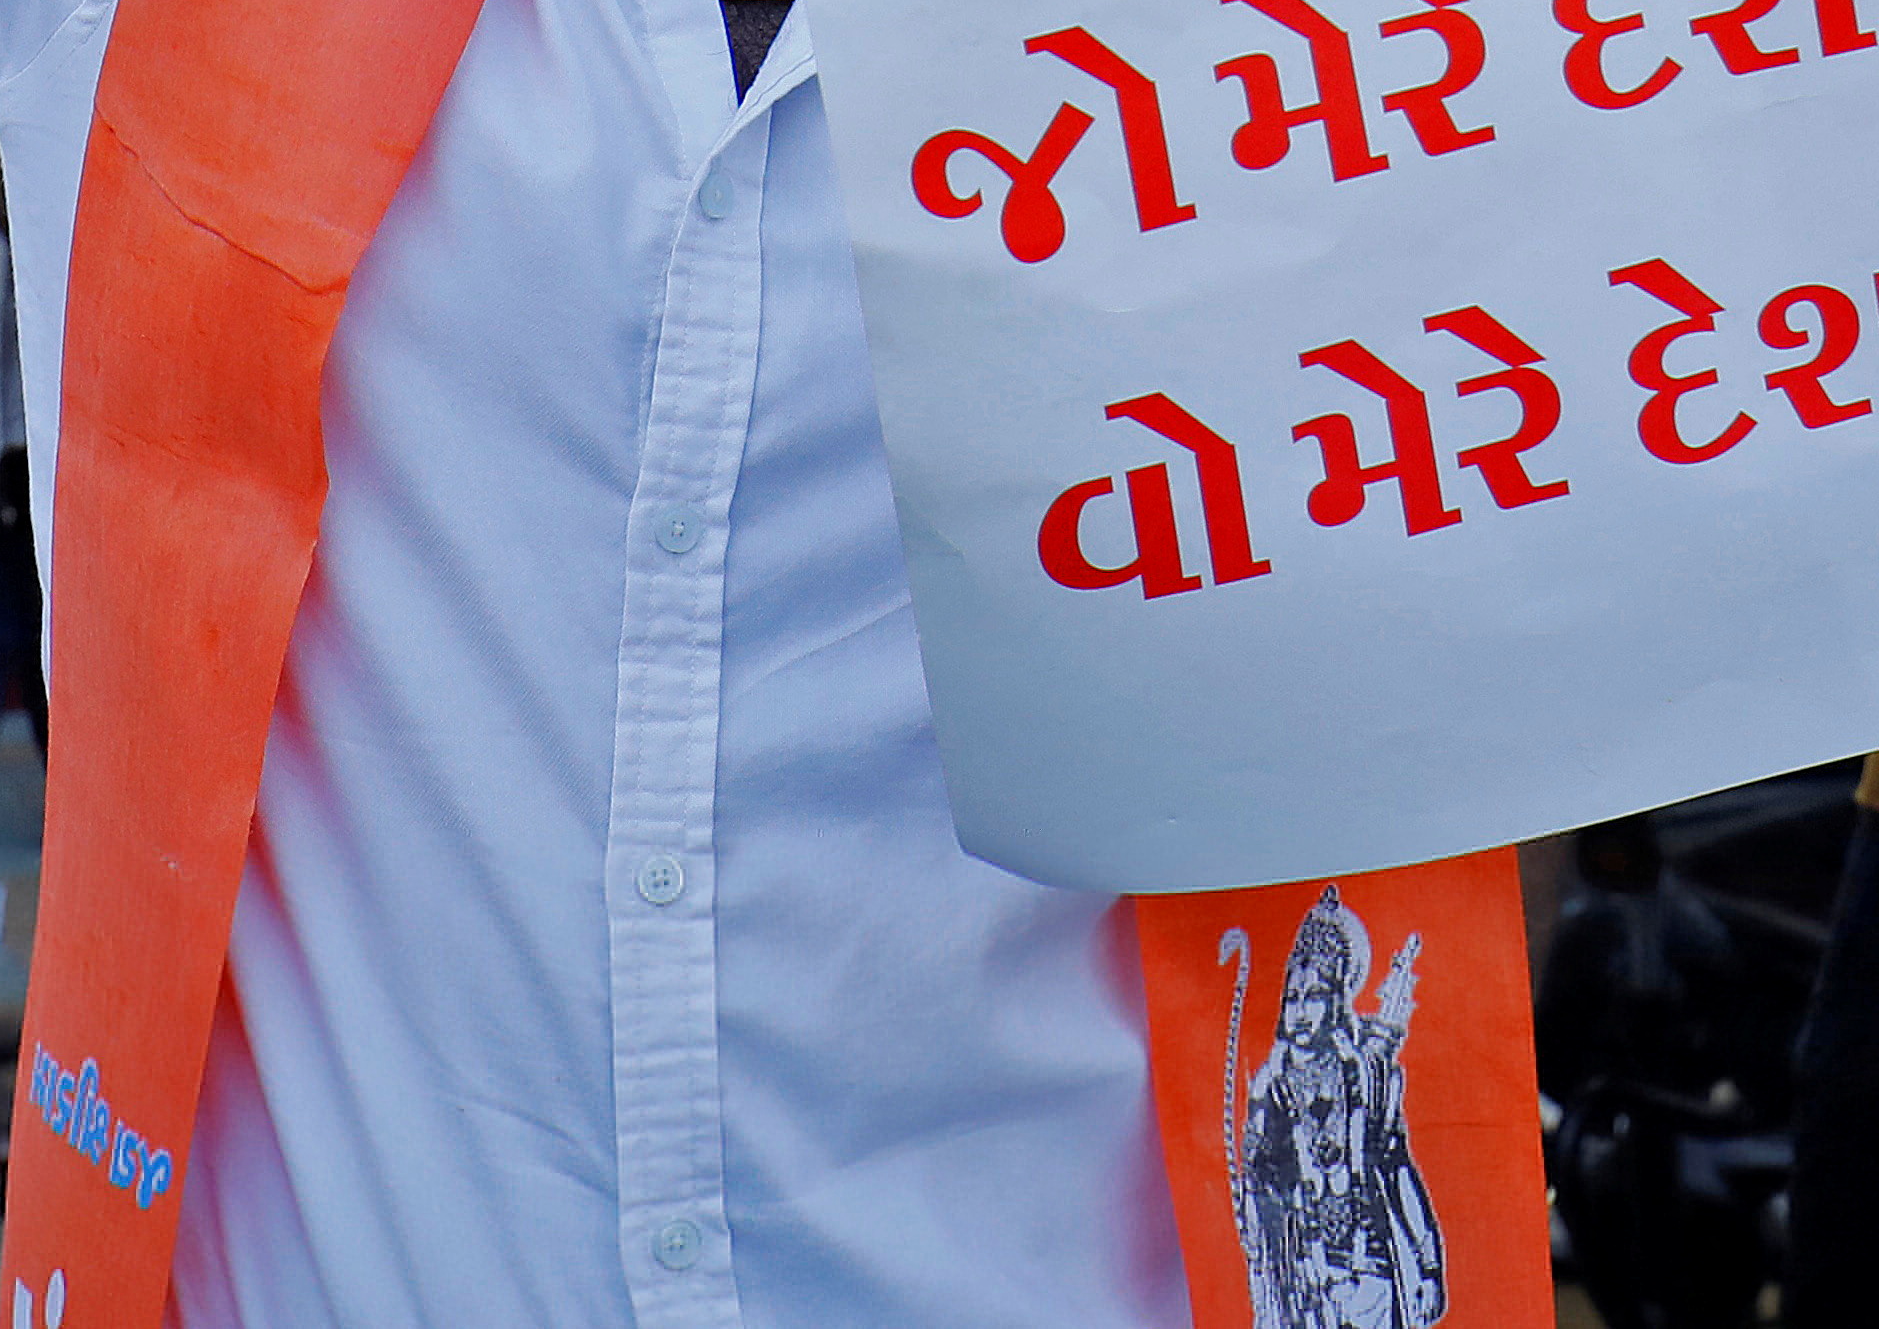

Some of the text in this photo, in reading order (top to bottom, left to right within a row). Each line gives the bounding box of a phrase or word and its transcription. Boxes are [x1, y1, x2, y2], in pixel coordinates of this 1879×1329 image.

[913, 27, 1196, 263] જો
[1040, 395, 1271, 597] વો
[1293, 307, 1569, 535] મેરે
